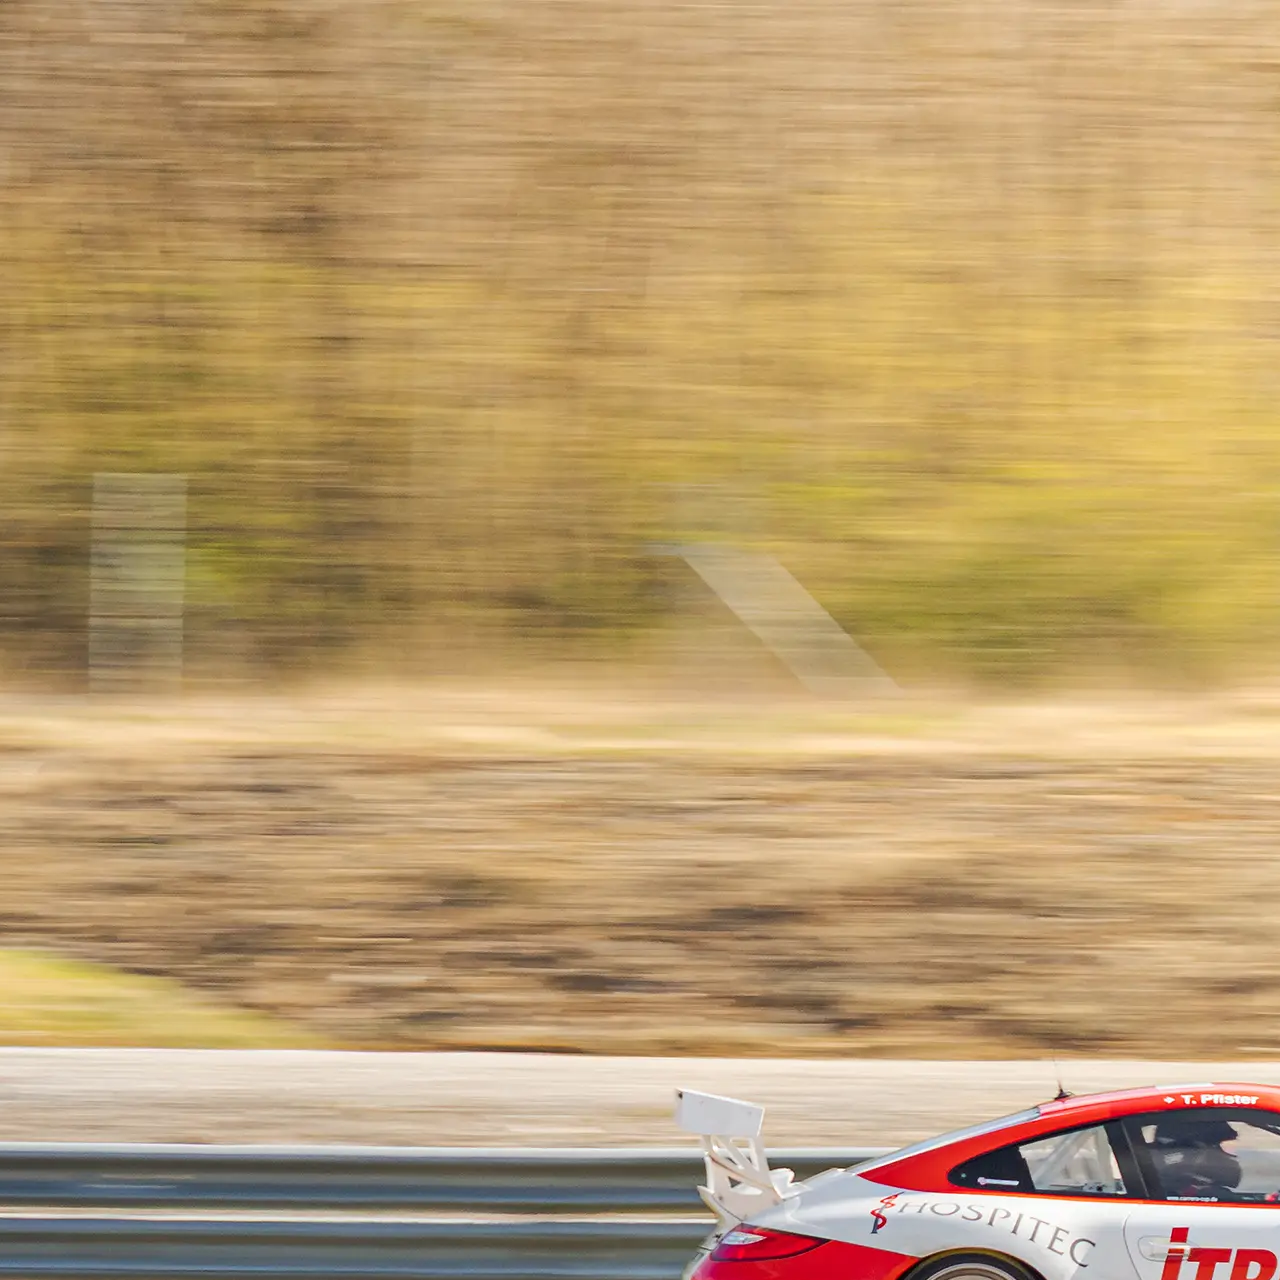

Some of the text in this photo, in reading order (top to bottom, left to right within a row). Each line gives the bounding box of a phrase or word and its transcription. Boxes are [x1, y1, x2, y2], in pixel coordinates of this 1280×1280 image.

[1180, 1094, 1259, 1104] T. Pfister
[897, 1202, 1097, 1268] HOSPITEC
